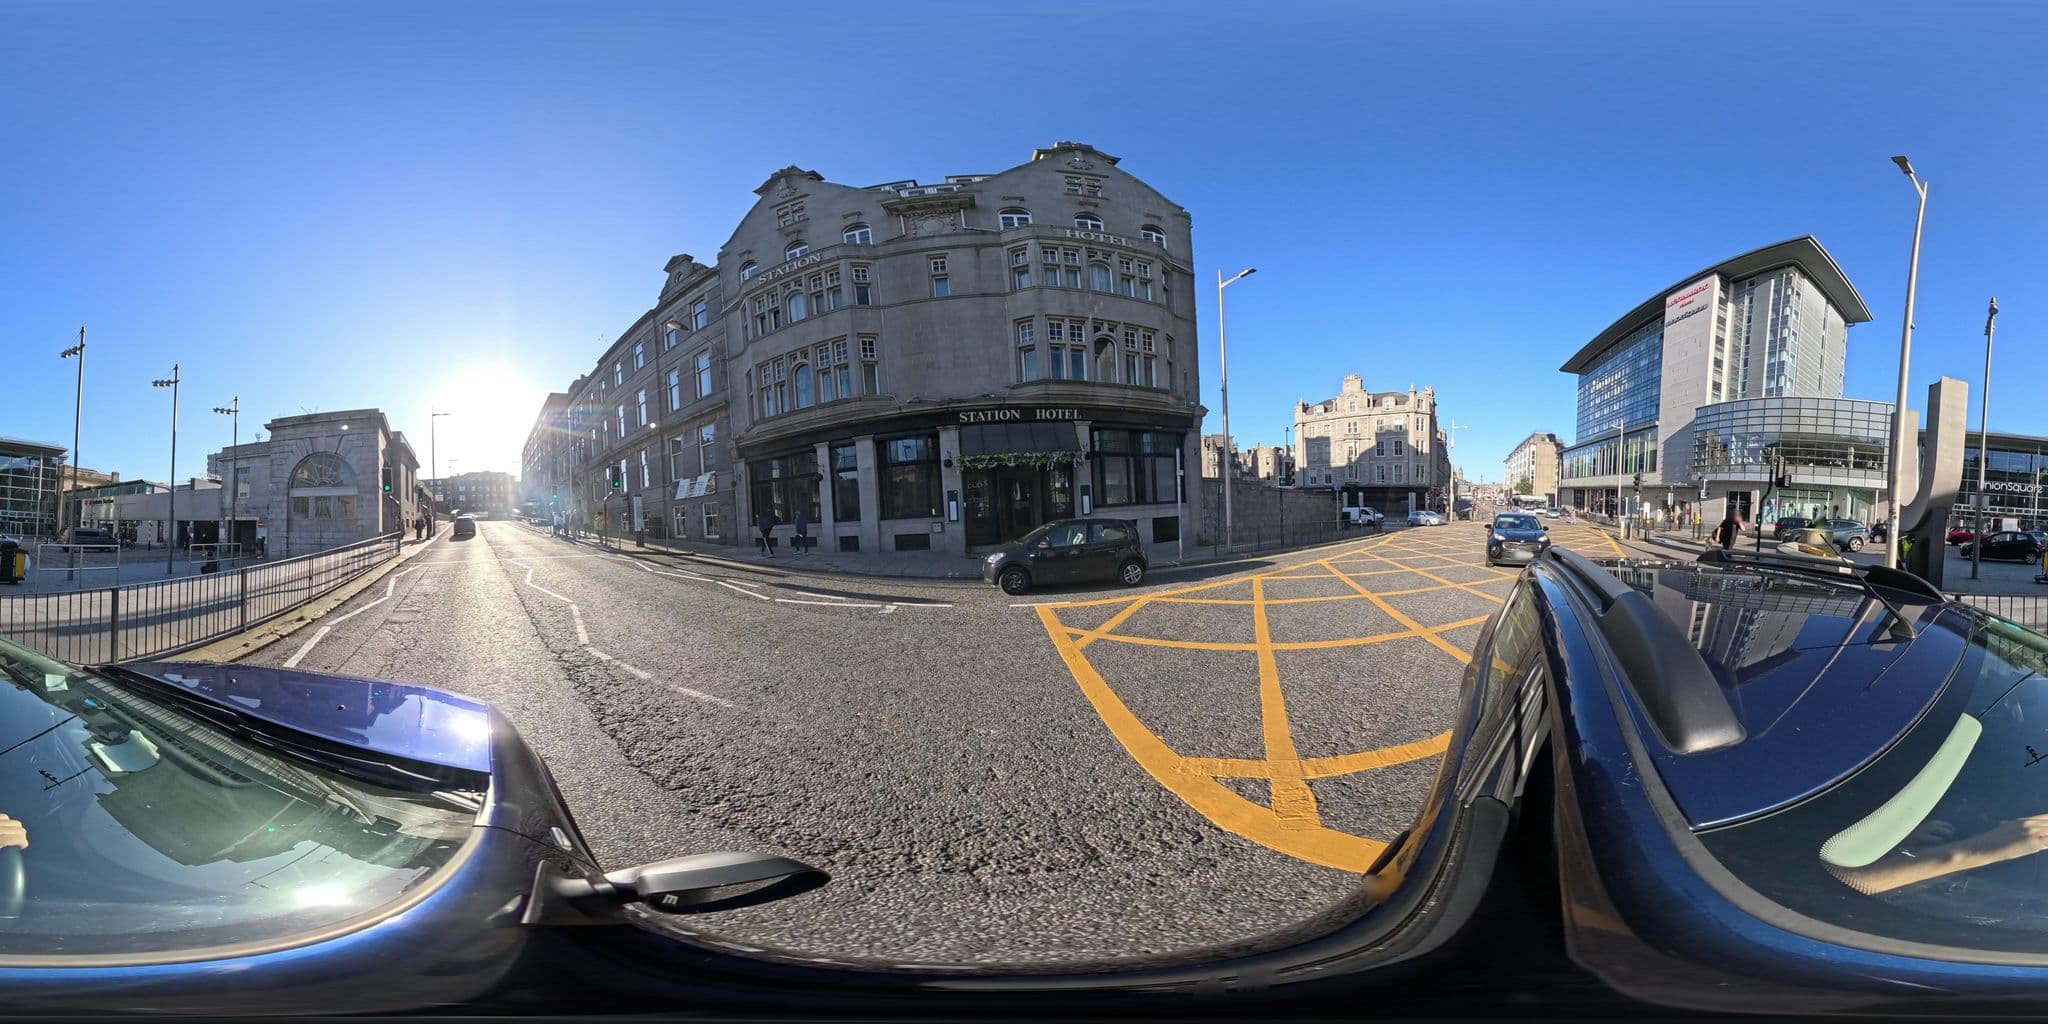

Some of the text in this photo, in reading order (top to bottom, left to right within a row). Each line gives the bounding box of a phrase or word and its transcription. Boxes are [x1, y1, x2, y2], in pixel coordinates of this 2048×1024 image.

[1065, 229, 1132, 247] HOTEL
[758, 253, 821, 284] STATION
[959, 408, 1081, 423] STATION HOTEL
[1983, 481, 2044, 494] nionSquare
